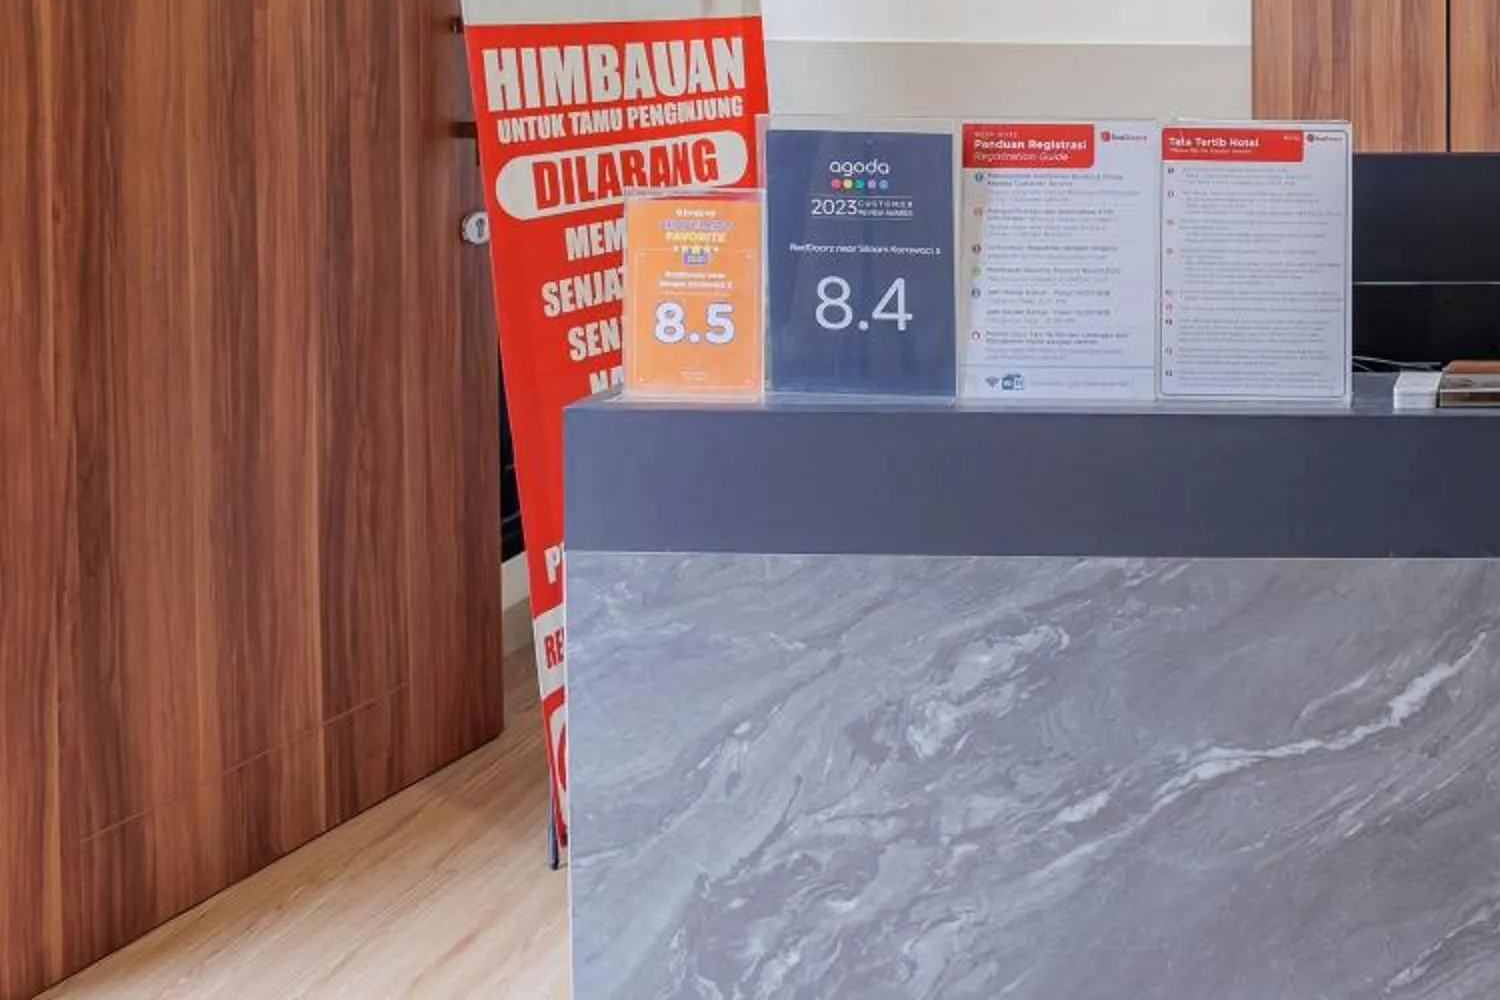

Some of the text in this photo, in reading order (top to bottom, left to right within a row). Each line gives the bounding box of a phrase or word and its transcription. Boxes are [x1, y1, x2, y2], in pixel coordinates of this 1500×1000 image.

[482, 36, 746, 113] HIMBAUAN
[497, 113, 565, 144] UNTUK
[569, 107, 622, 137] TAMU
[974, 139, 1087, 151] Panduan Registrasi
[1195, 136, 1227, 147] Tertib
[1229, 137, 1260, 147] Hotel
[531, 138, 719, 211] DILARANG
[829, 158, 890, 177] agoda
[973, 151, 1069, 163] Registration Guide
[811, 199, 857, 215] 2023
[565, 218, 626, 262] MEM
[541, 266, 625, 318] SENJA
[815, 274, 913, 332] 8.4
[655, 300, 735, 344] 8.5
